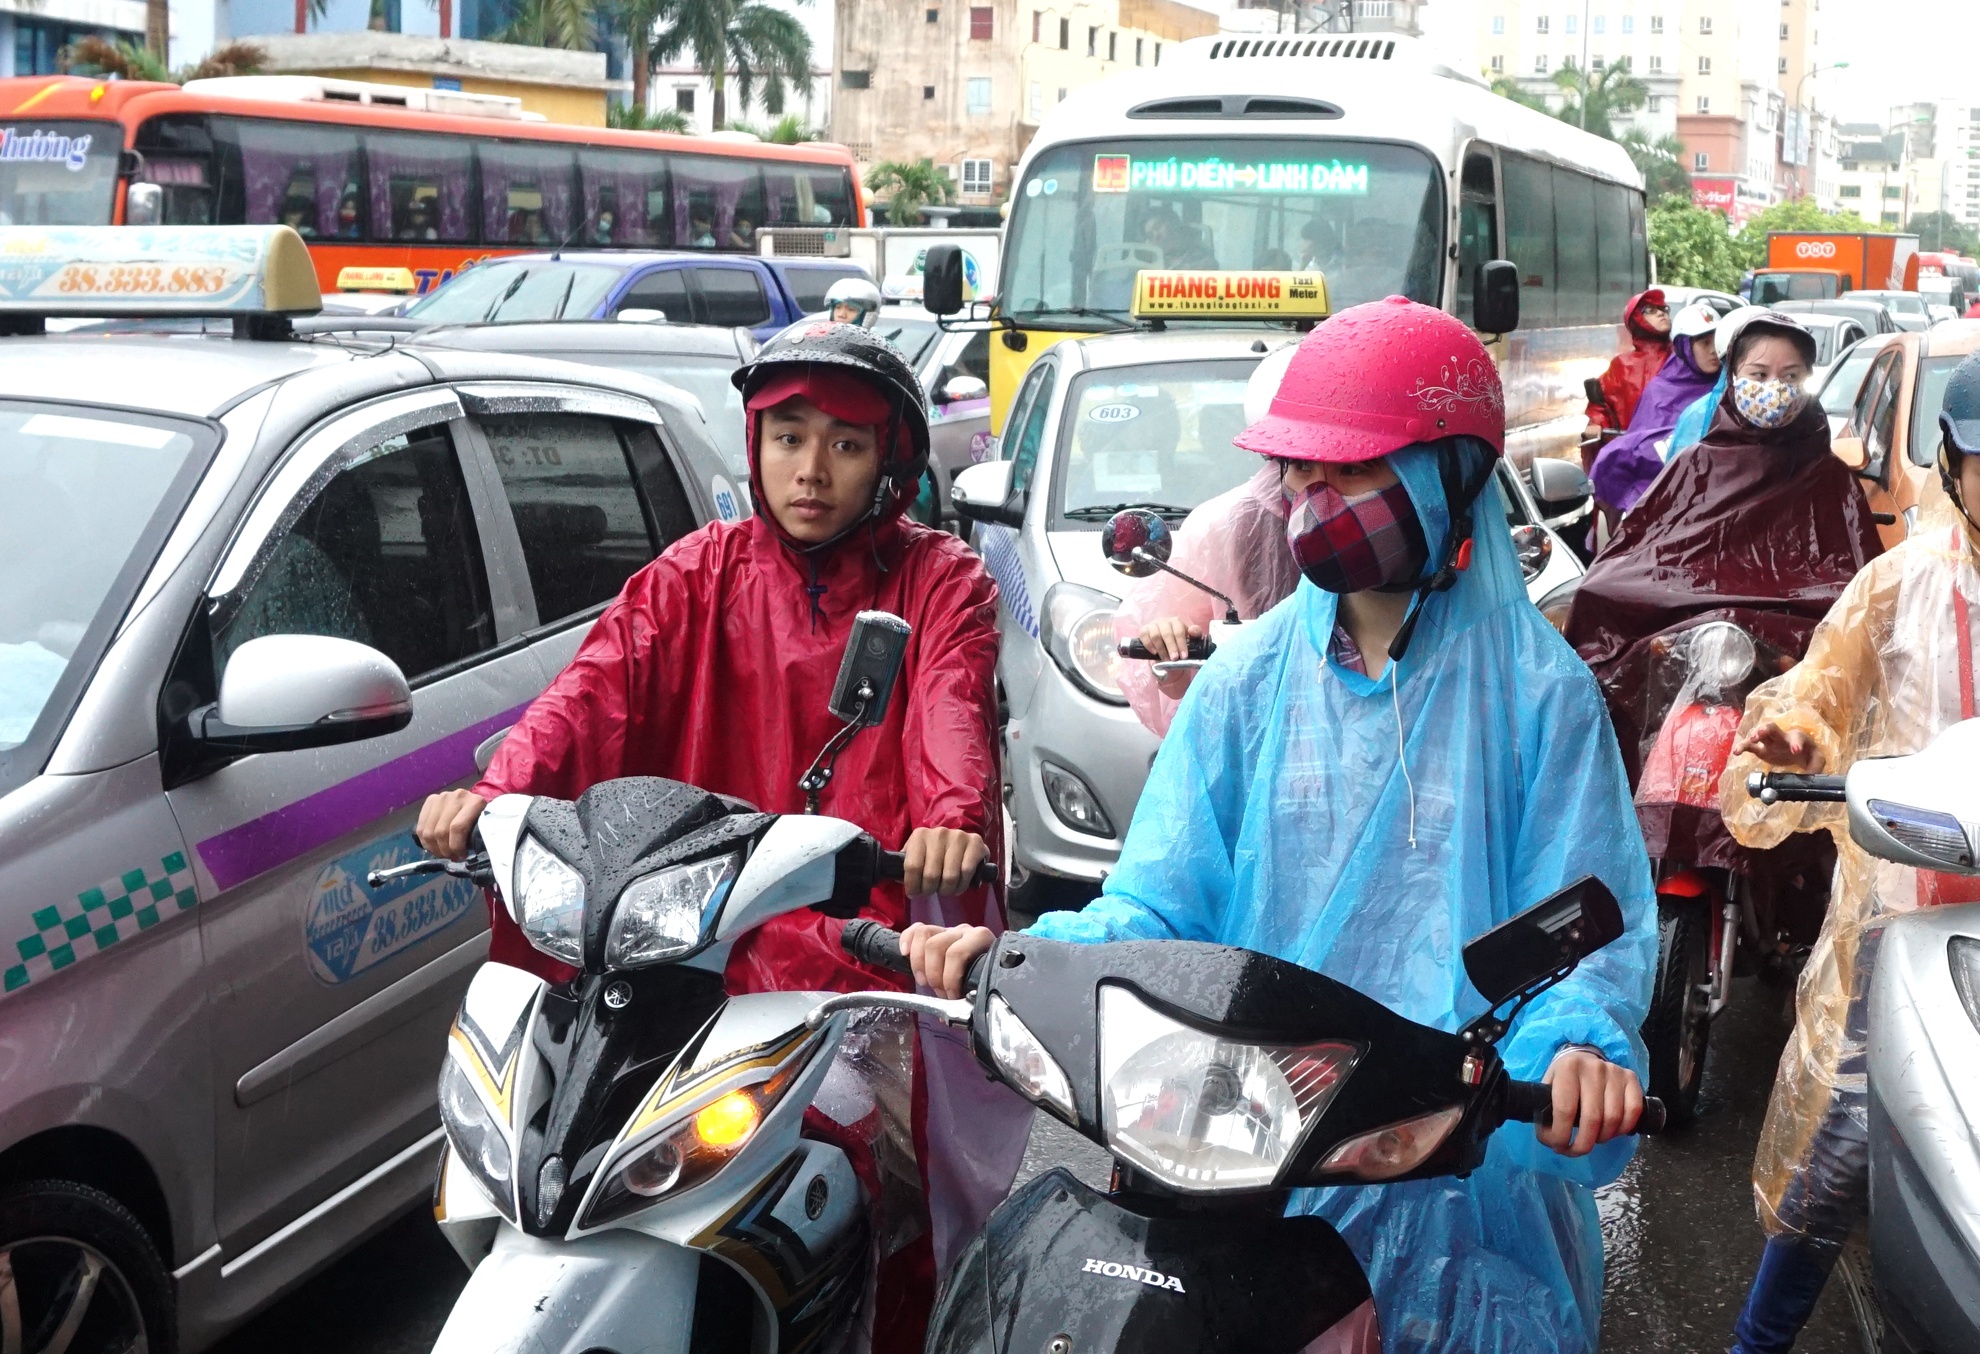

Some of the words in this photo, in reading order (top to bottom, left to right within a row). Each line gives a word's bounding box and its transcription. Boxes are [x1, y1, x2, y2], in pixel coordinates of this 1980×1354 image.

[0, 127, 93, 172] hương
[1097, 158, 1128, 187] 05
[1132, 156, 1177, 188] PHÚ
[1257, 163, 1309, 190] LINH
[1311, 158, 1368, 191] ĐÀM
[1798, 243, 1834, 257] TNT
[1147, 273, 1218, 299] THĂNG
[1224, 276, 1281, 299] LONG
[1289, 288, 1318, 299] Meter
[1292, 276, 1313, 286] Taxi
[1100, 408, 1132, 419] 603
[715, 490, 738, 520] 691
[1081, 1258, 1186, 1294] HONDA
